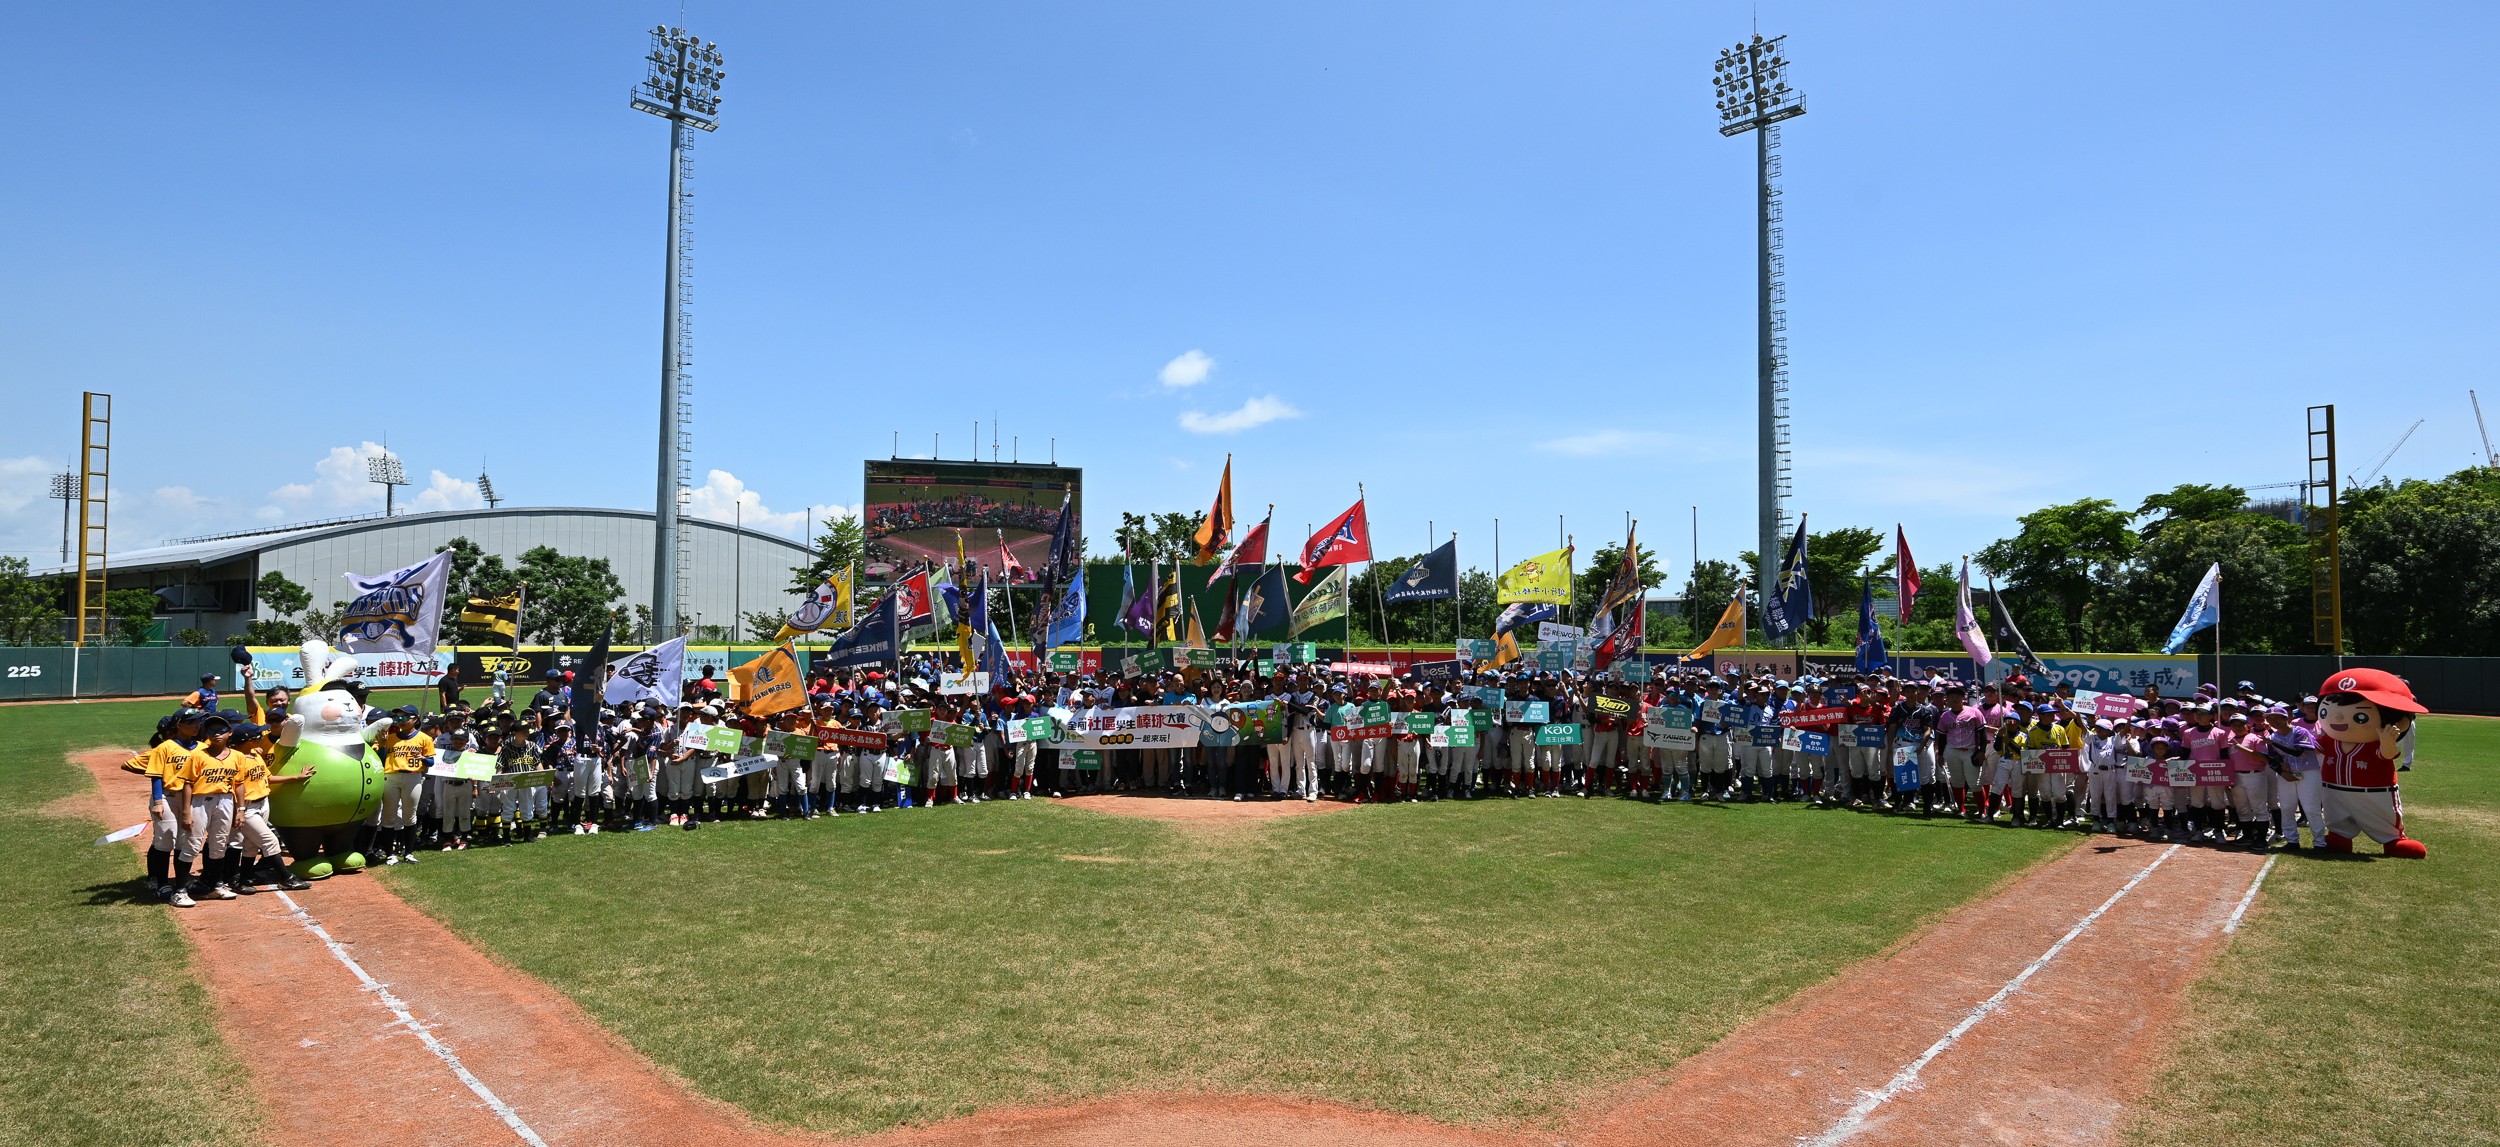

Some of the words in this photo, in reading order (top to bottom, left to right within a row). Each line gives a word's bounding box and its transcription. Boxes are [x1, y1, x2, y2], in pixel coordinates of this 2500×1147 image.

[1215, 657, 1231, 665] 275
[8, 665, 41, 678] 225
[1421, 665, 1450, 677] best
[1596, 695, 1628, 711] BRETT
[1134, 734, 1171, 744] 一起來玩!
